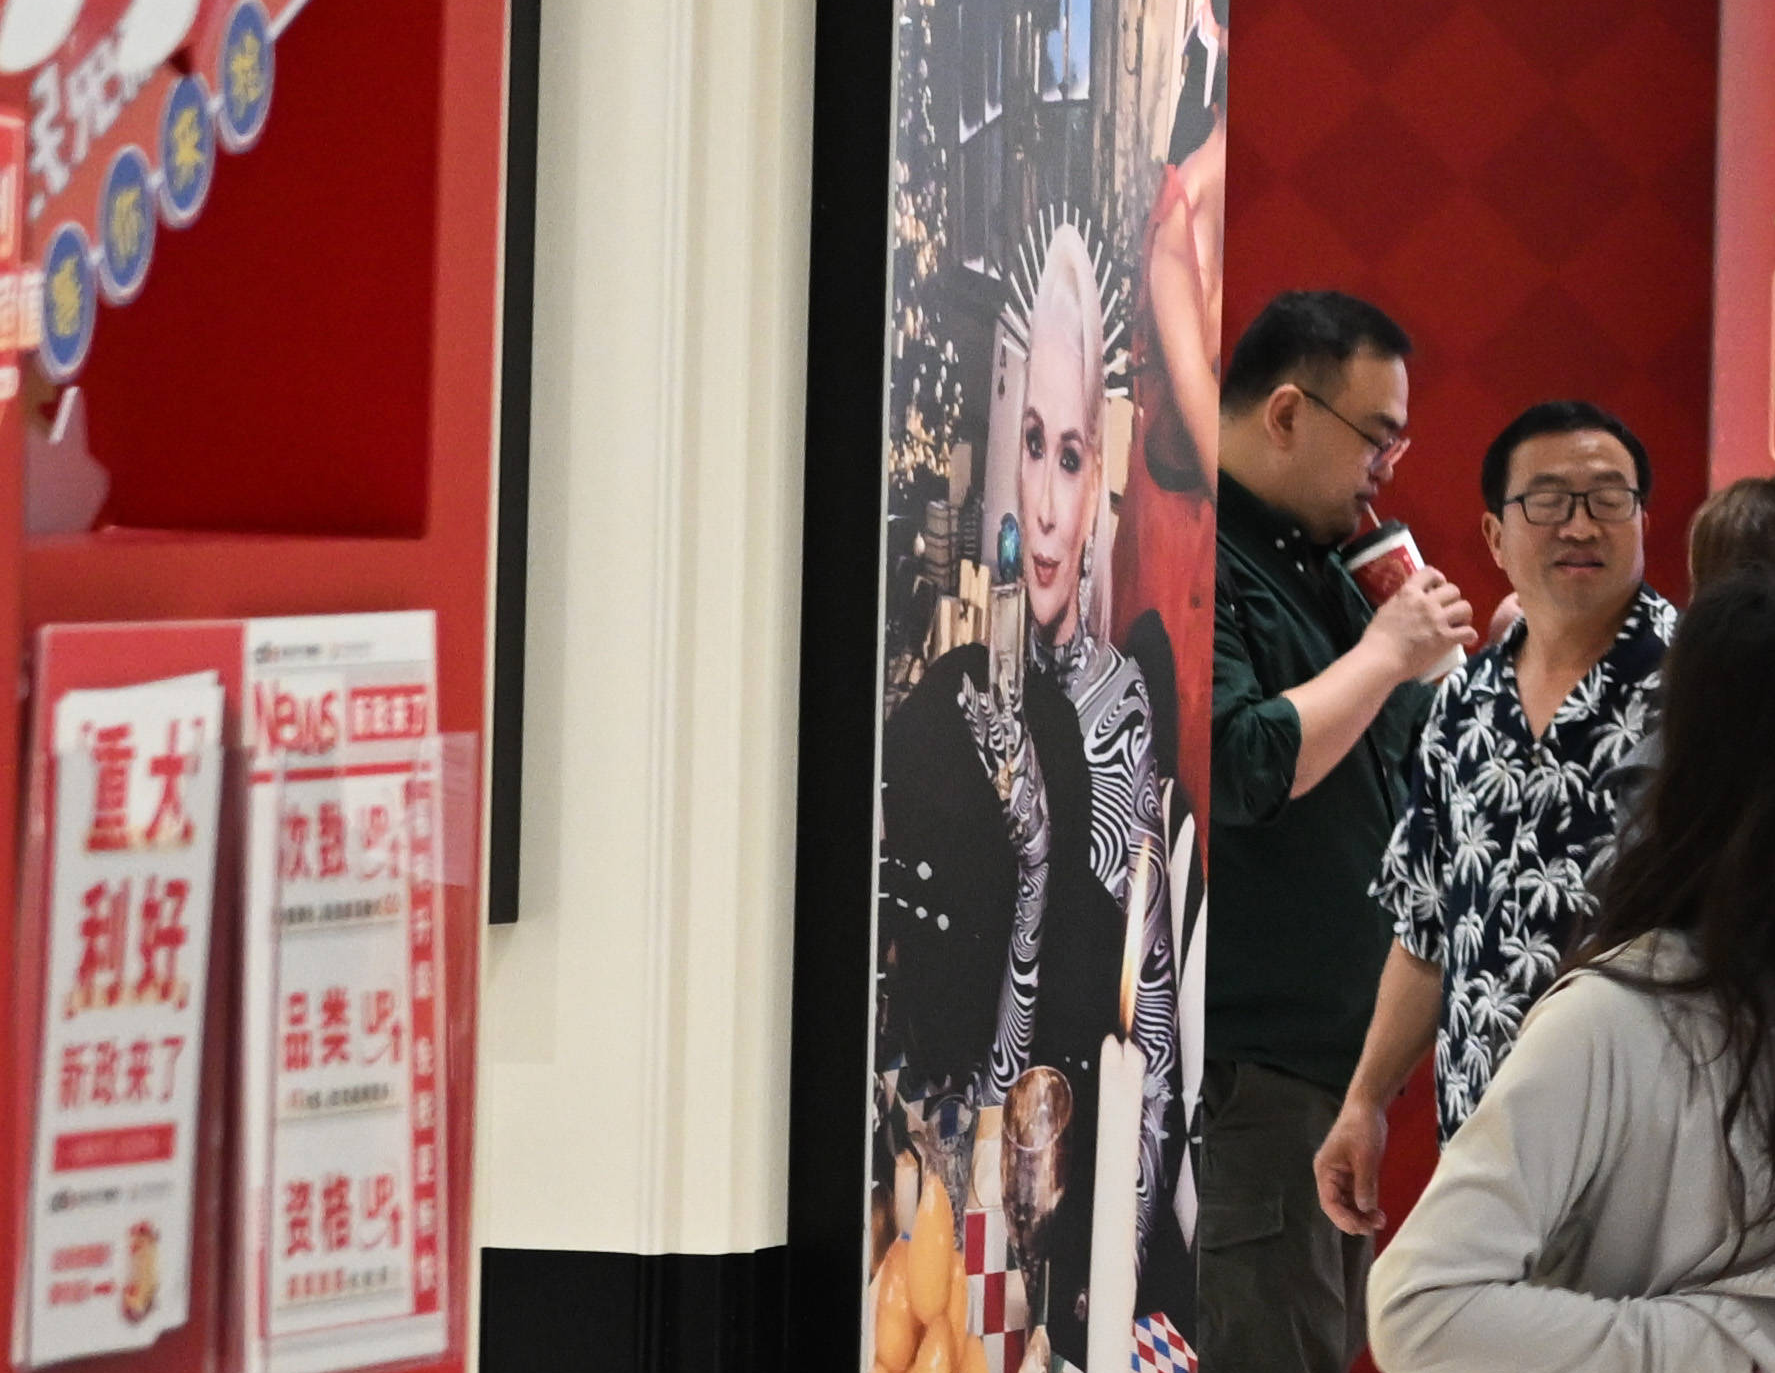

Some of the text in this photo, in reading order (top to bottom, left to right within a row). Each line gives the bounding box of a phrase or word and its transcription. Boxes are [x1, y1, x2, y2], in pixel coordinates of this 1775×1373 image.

[66, 875, 192, 1017] 利好
[284, 989, 351, 1072] 品类
[58, 1034, 187, 1112] 新政来了
